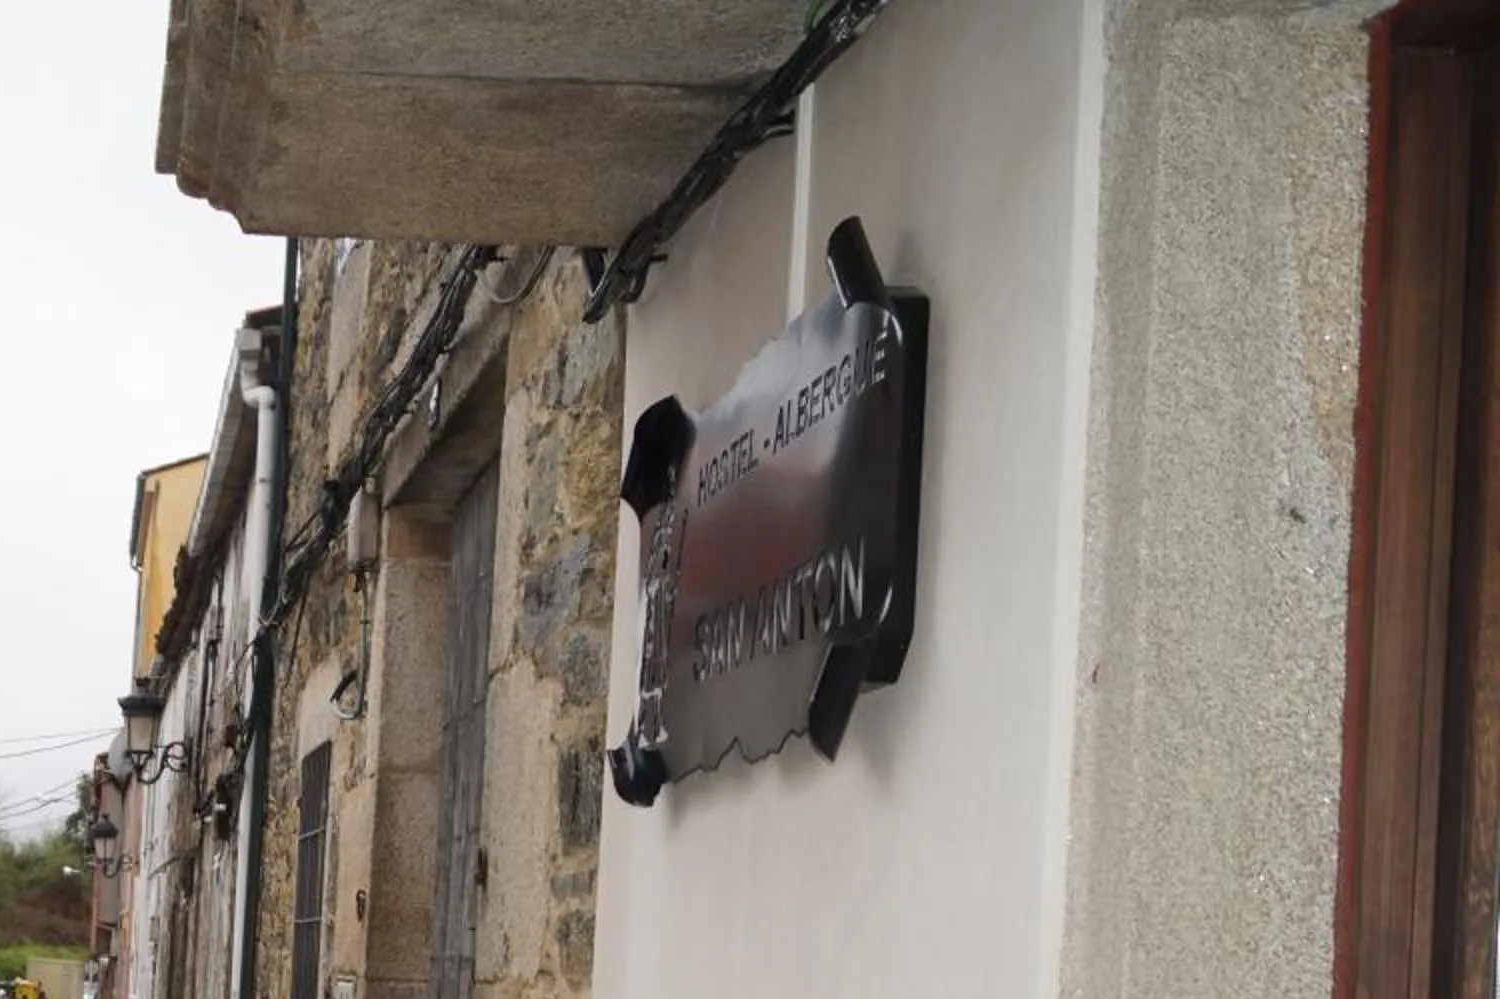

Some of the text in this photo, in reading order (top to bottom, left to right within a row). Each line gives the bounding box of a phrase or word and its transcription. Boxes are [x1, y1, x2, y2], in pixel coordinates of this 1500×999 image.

[697, 428, 759, 508] HOSTEL
[773, 331, 887, 455] ALBERGUE
[692, 534, 865, 684] SAN ANTON
